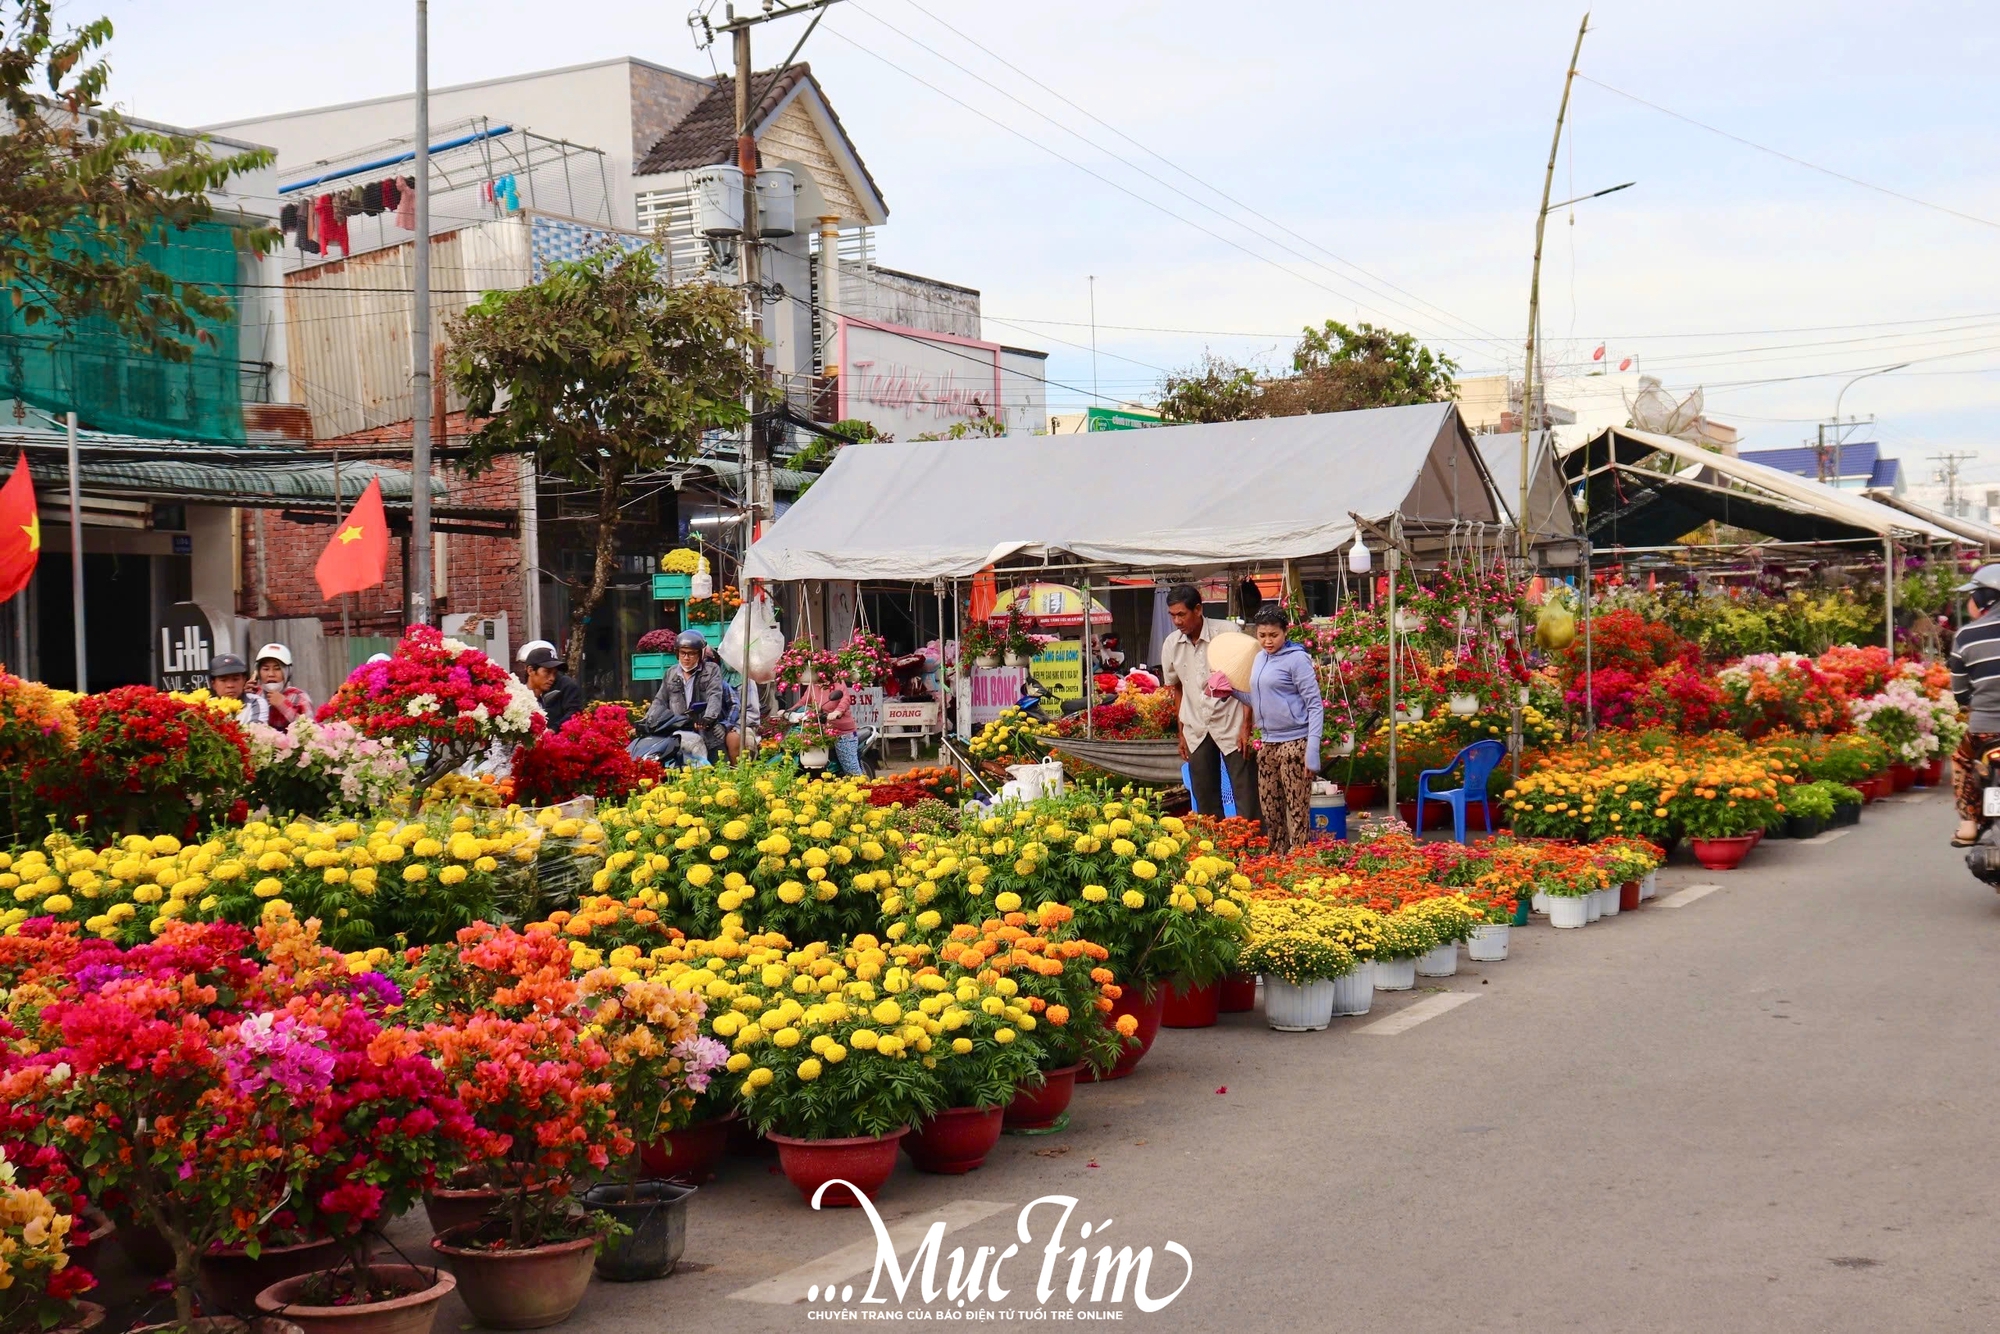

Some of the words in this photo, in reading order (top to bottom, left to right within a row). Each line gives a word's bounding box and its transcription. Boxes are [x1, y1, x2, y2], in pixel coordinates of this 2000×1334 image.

[853, 361, 931, 419] Teddy's
[934, 368, 991, 419] House
[162, 676, 185, 691] NAIL
[190, 674, 211, 690] SPA
[990, 668, 1018, 707] BÔNG
